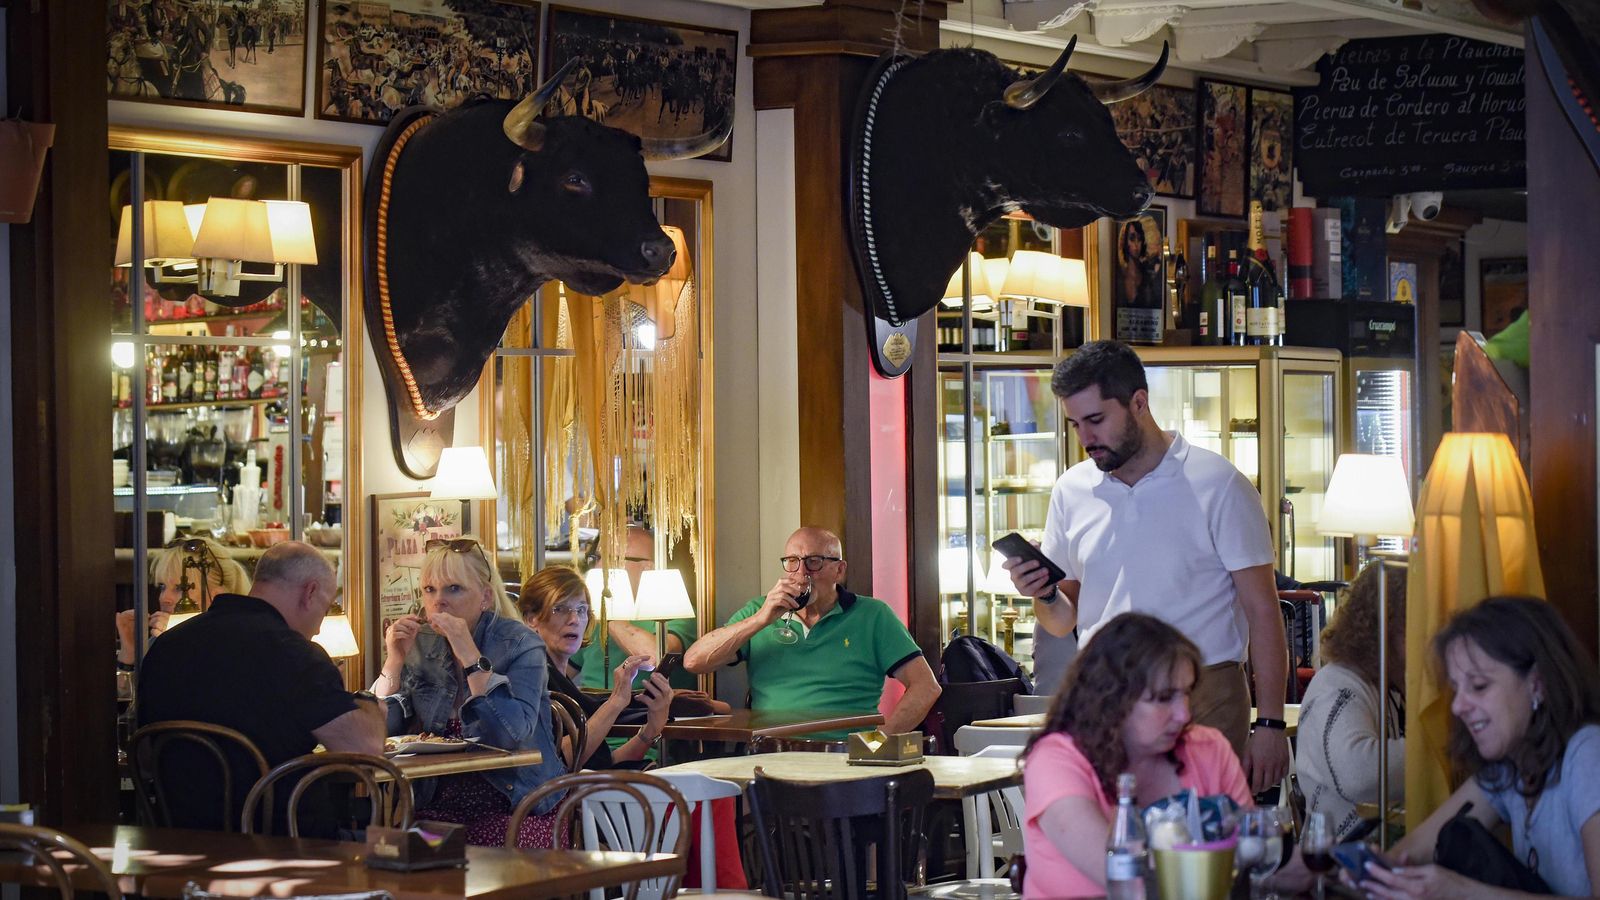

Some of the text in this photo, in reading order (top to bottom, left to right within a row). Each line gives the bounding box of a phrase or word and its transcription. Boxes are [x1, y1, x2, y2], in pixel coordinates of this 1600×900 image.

[1400, 47, 1409, 61] a
[1417, 38, 1434, 60] la
[1368, 67, 1388, 90] de
[1360, 95, 1379, 118] de
[1384, 92, 1449, 117] Cordero
[1457, 92, 1476, 113] al
[1385, 120, 1407, 145] de
[386, 536, 418, 558] PLAZA
